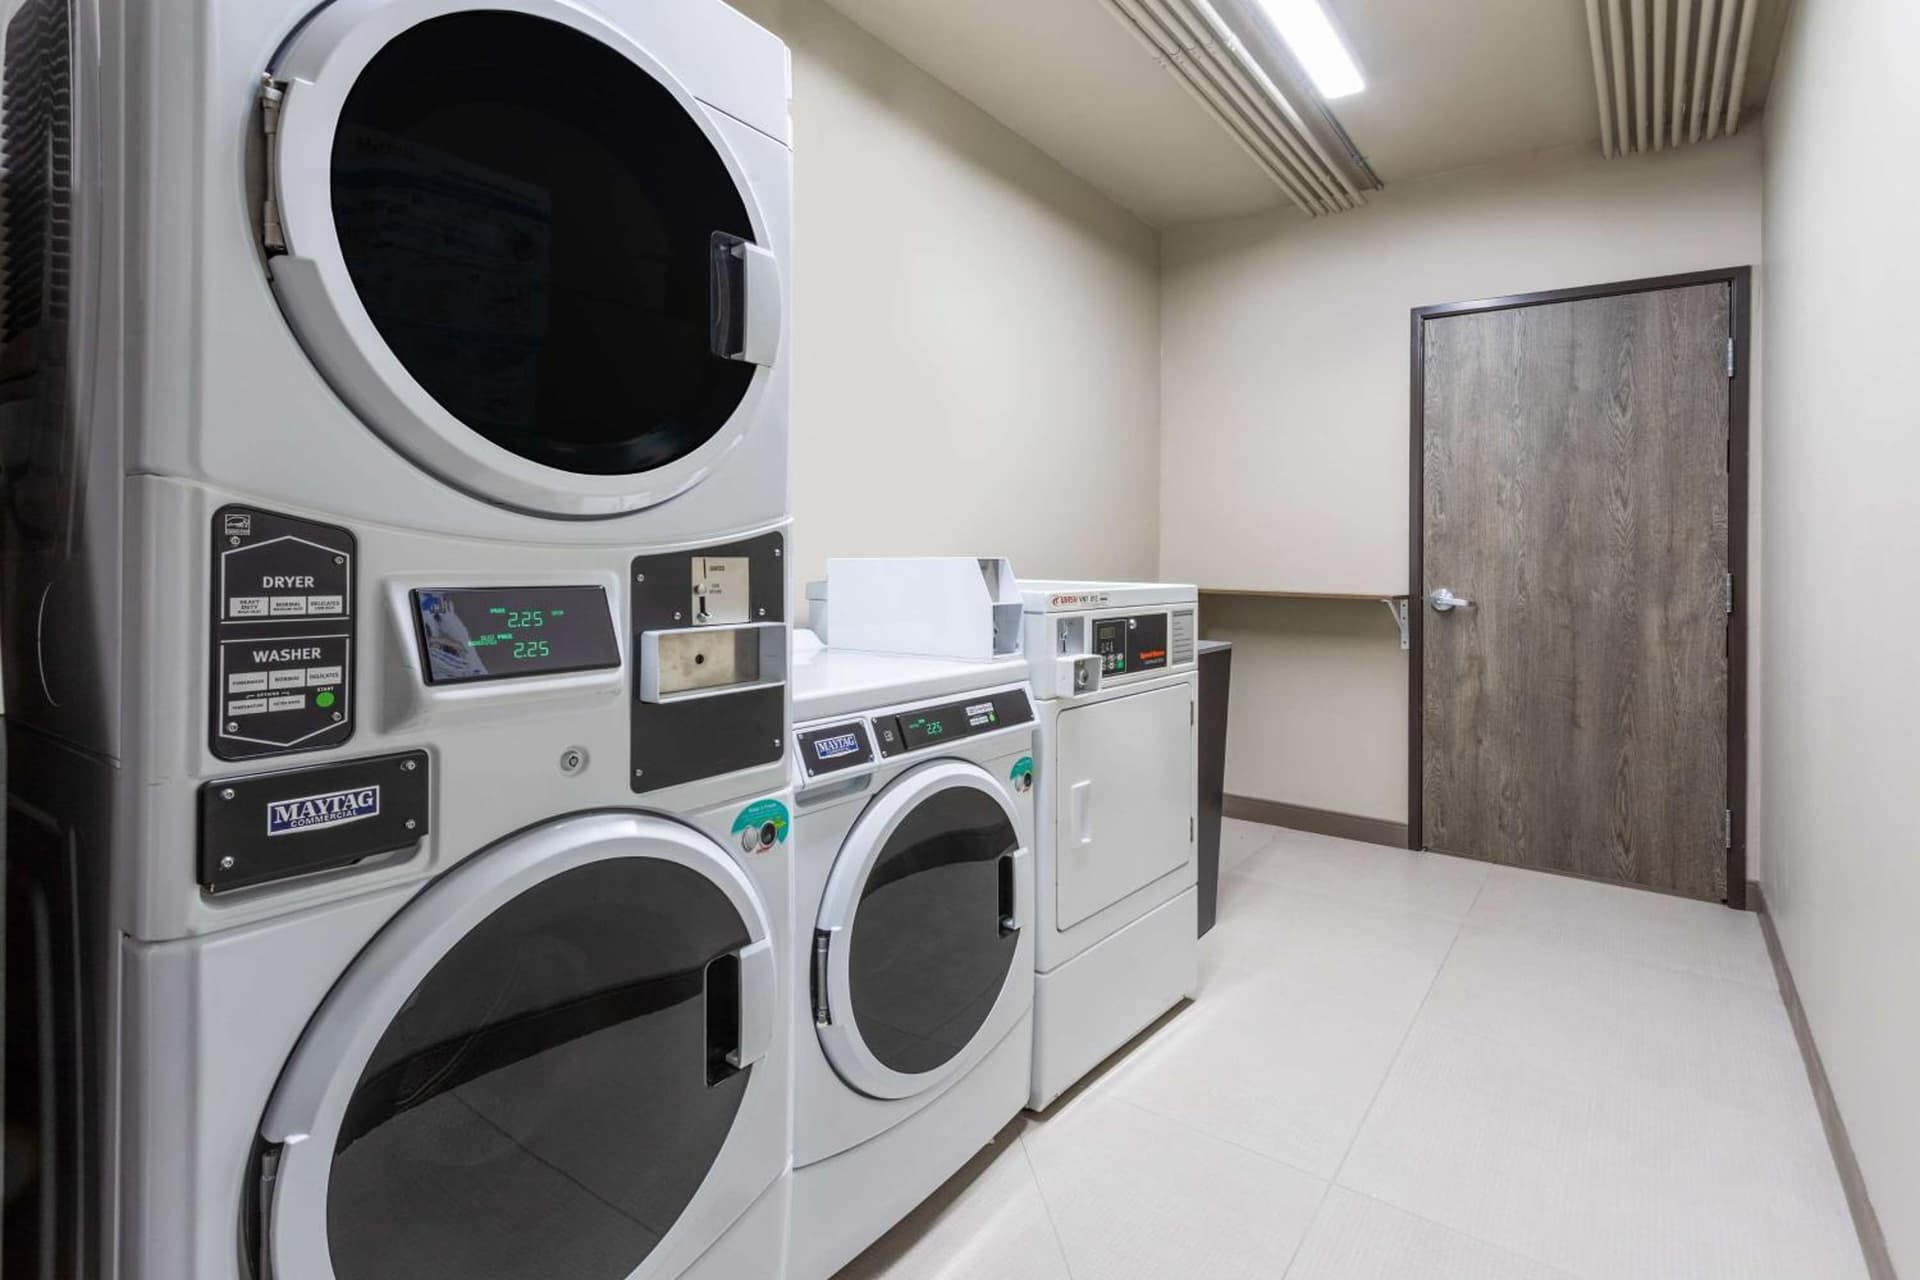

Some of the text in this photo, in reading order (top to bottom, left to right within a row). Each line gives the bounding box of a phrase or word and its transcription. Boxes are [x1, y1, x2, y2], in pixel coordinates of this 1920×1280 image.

[262, 575, 315, 589] DRYER
[507, 610, 544, 628] 2.25
[252, 647, 322, 663] WASHER
[513, 641, 550, 659] 2.25
[818, 736, 854, 753] MAYTAG
[273, 790, 374, 824] MAYTAG
[290, 809, 358, 828] COMMERCIAL
